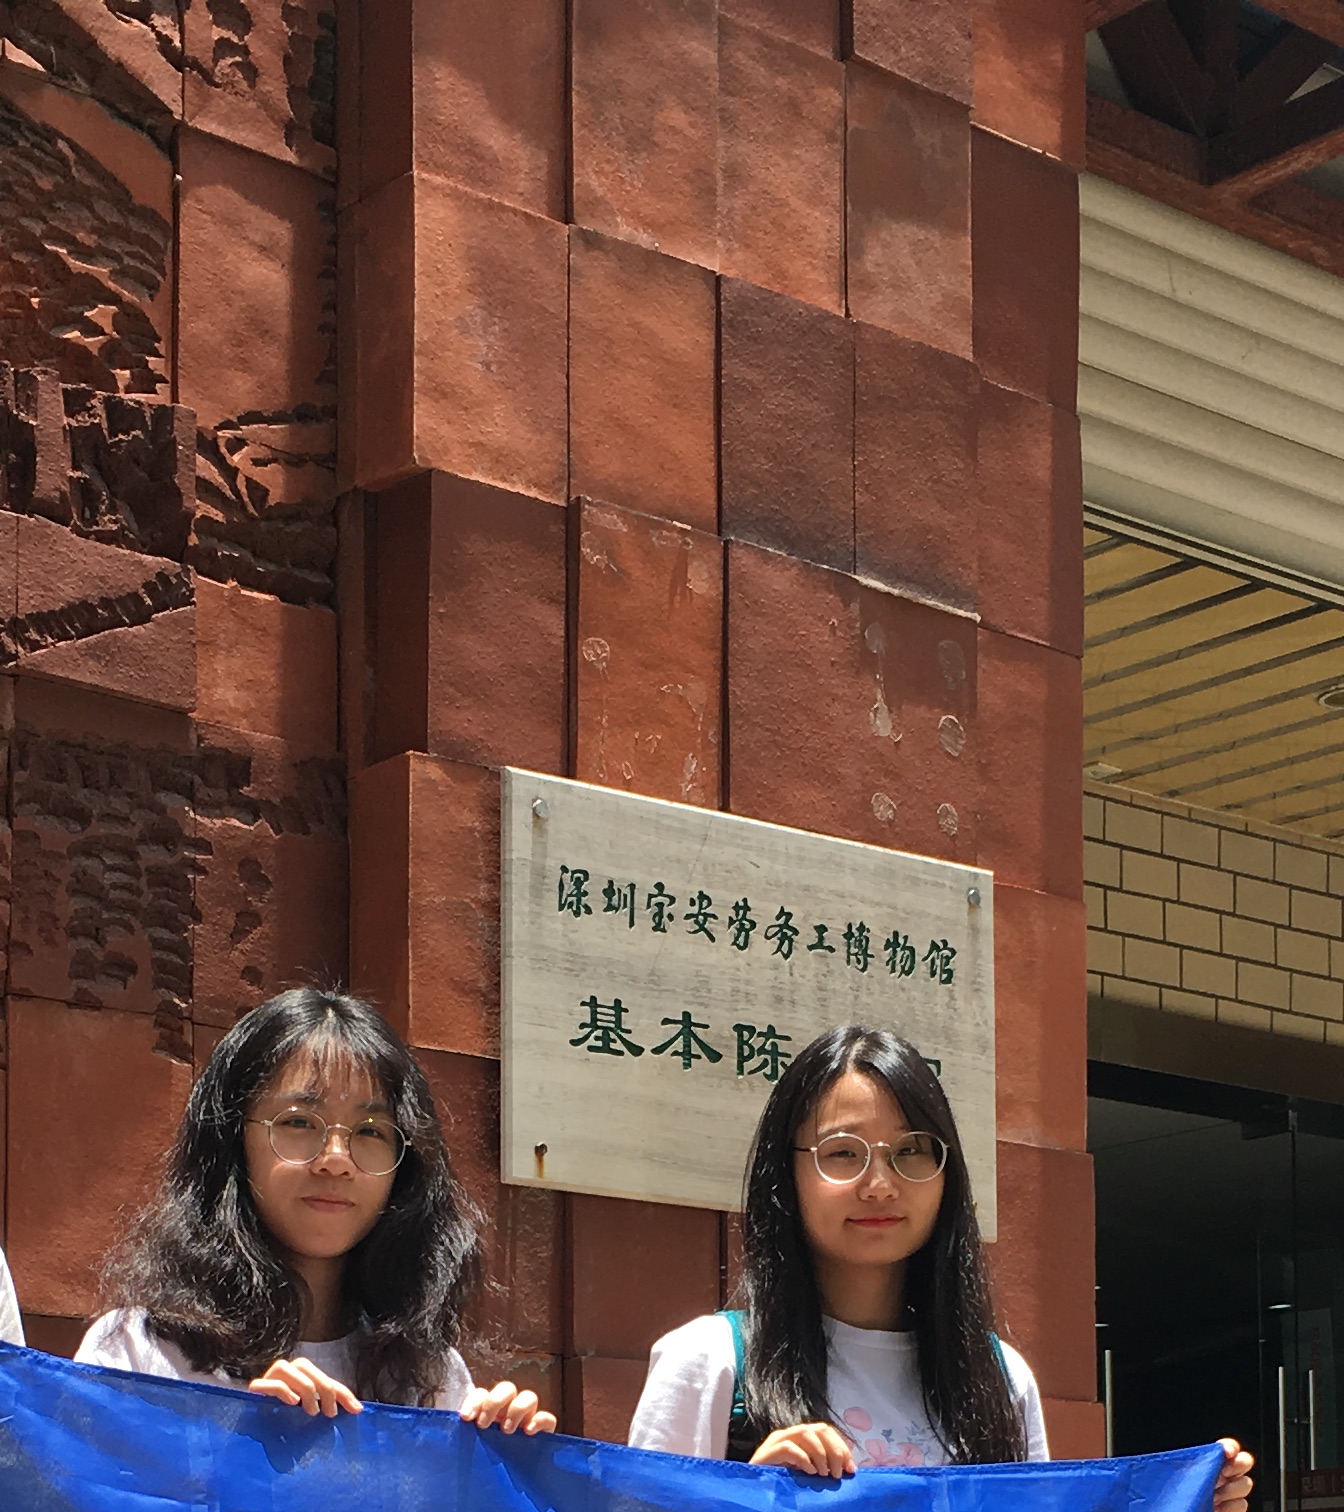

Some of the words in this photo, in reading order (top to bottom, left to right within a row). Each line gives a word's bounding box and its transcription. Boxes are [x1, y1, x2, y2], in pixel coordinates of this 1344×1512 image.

[557, 865, 958, 985] 深圳宝安劳务工博物馆
